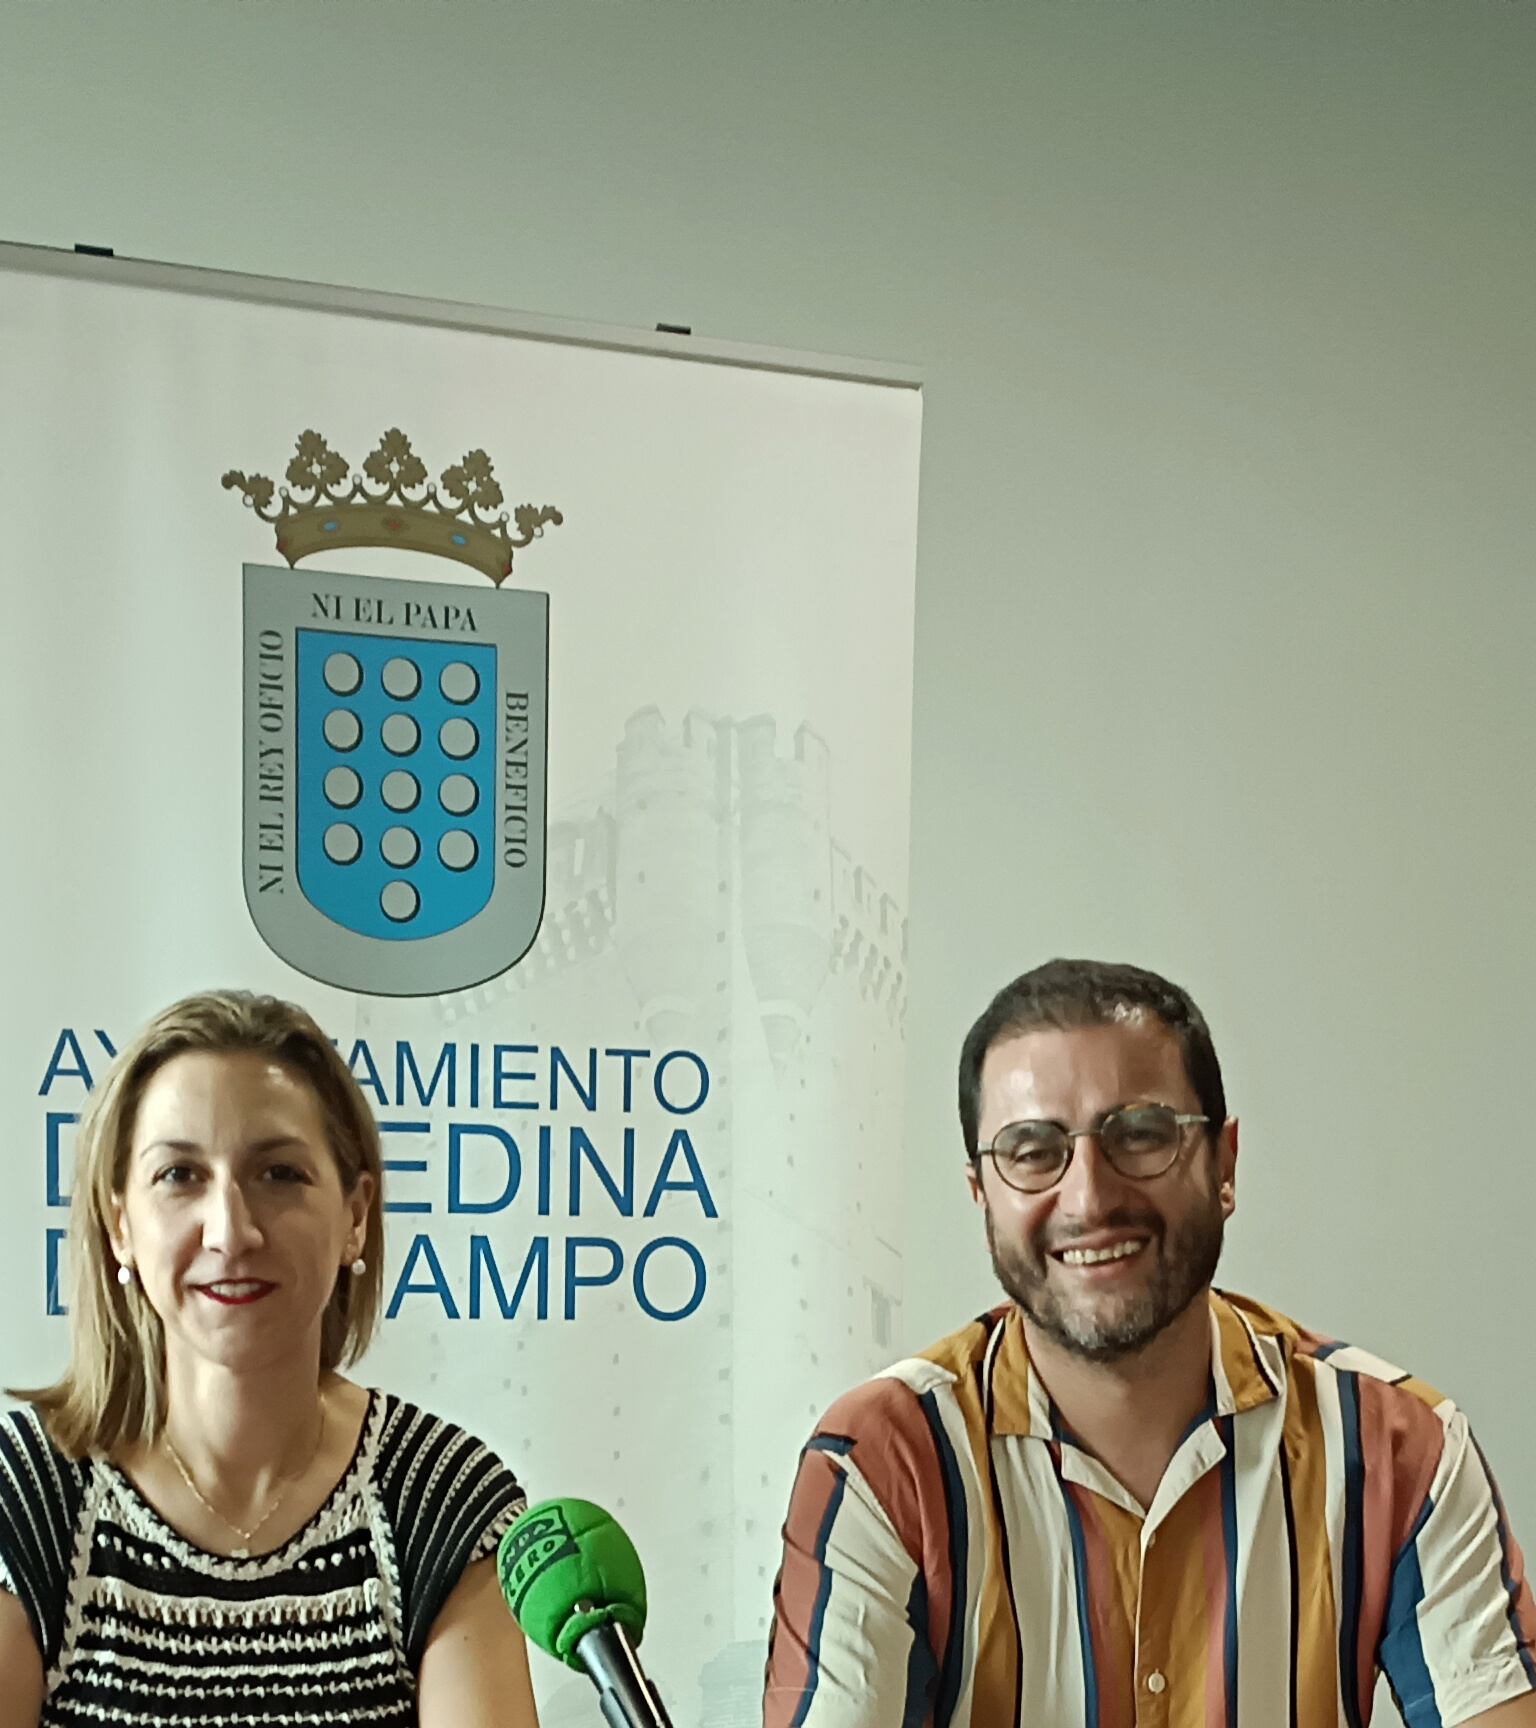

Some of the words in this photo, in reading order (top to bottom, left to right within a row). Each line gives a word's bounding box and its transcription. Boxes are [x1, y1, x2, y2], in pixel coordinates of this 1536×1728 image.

[312, 592, 341, 620] NI
[354, 598, 394, 625] EL
[404, 602, 478, 633] PAPA
[259, 629, 284, 733] OFICIO
[259, 740, 284, 803] REY
[503, 691, 529, 868] BENEFICIO
[259, 811, 284, 853] EL
[259, 863, 284, 895] NI
[378, 1115, 718, 1218] EDINA
[385, 1233, 708, 1322] AMPO
